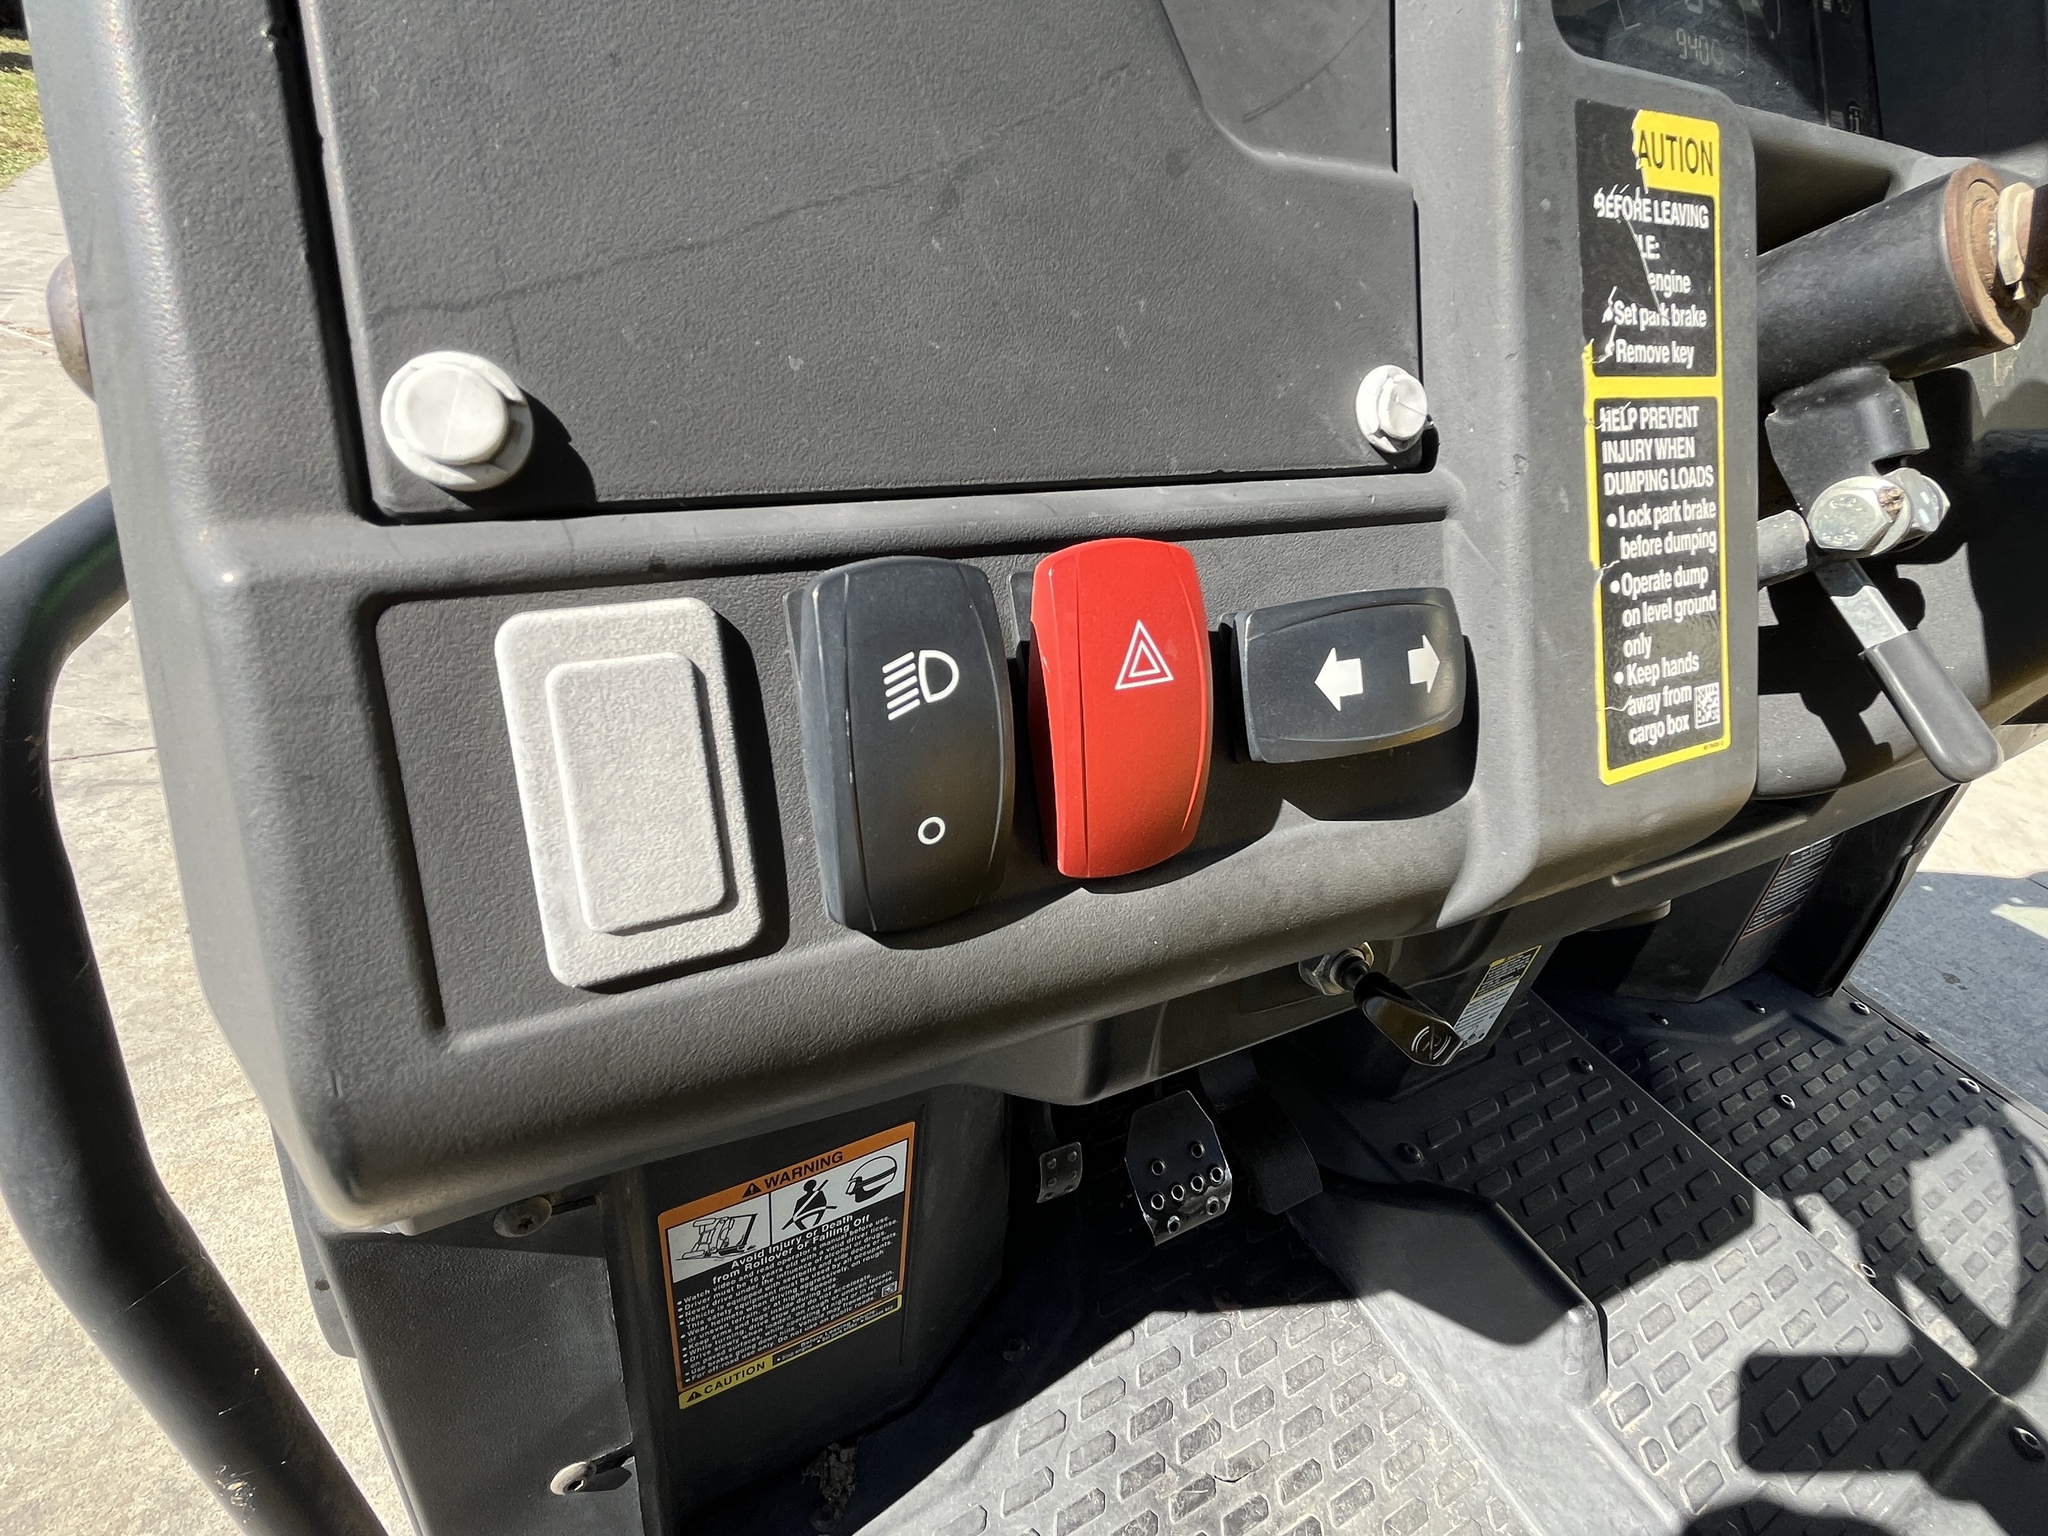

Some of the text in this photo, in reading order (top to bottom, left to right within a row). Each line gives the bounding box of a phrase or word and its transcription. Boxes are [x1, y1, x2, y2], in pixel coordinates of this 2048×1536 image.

[1638, 130, 1714, 176] AUTION
[1594, 193, 1710, 230] BEFORE LEAVING
[1649, 269, 1691, 298] engine
[1614, 300, 1707, 331] Set park brake
[1616, 339, 1694, 369] Remove key
[1601, 405, 1700, 432] HELP PREVENT
[1602, 437, 1695, 464] INJURY WHEN
[1603, 465, 1715, 496] DUMPING LOADS
[1619, 498, 1716, 530] Lock park brake
[1620, 528, 1717, 560] before dumping
[1621, 565, 1709, 600] Operate dump
[1622, 590, 1717, 627] on level ground
[1623, 632, 1652, 659] only
[1627, 651, 1700, 686] Keep hands
[1627, 685, 1692, 717] away from
[1629, 714, 1690, 745] cargo box
[764, 1150, 842, 1189] WARNING
[712, 1214, 869, 1284] from Rollover or Falling Off
[730, 1213, 852, 1269] Avoid Injury or Death
[704, 1359, 764, 1395] CAUTION
